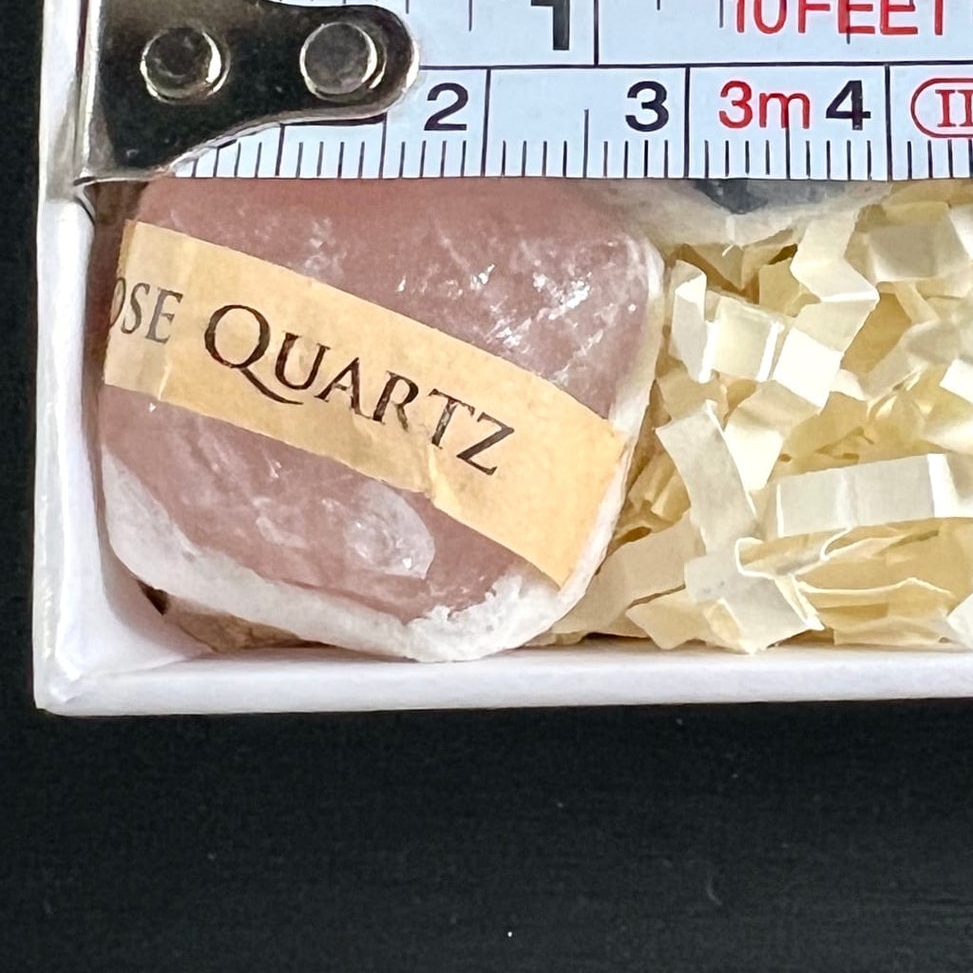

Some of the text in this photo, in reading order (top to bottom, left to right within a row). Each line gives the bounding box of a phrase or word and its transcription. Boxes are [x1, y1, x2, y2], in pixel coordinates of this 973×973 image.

[423, 82, 469, 132] 2
[625, 80, 669, 132] 3
[718, 80, 811, 130] 3m
[825, 80, 871, 131] 4
[203, 304, 516, 477] QUARTZ
